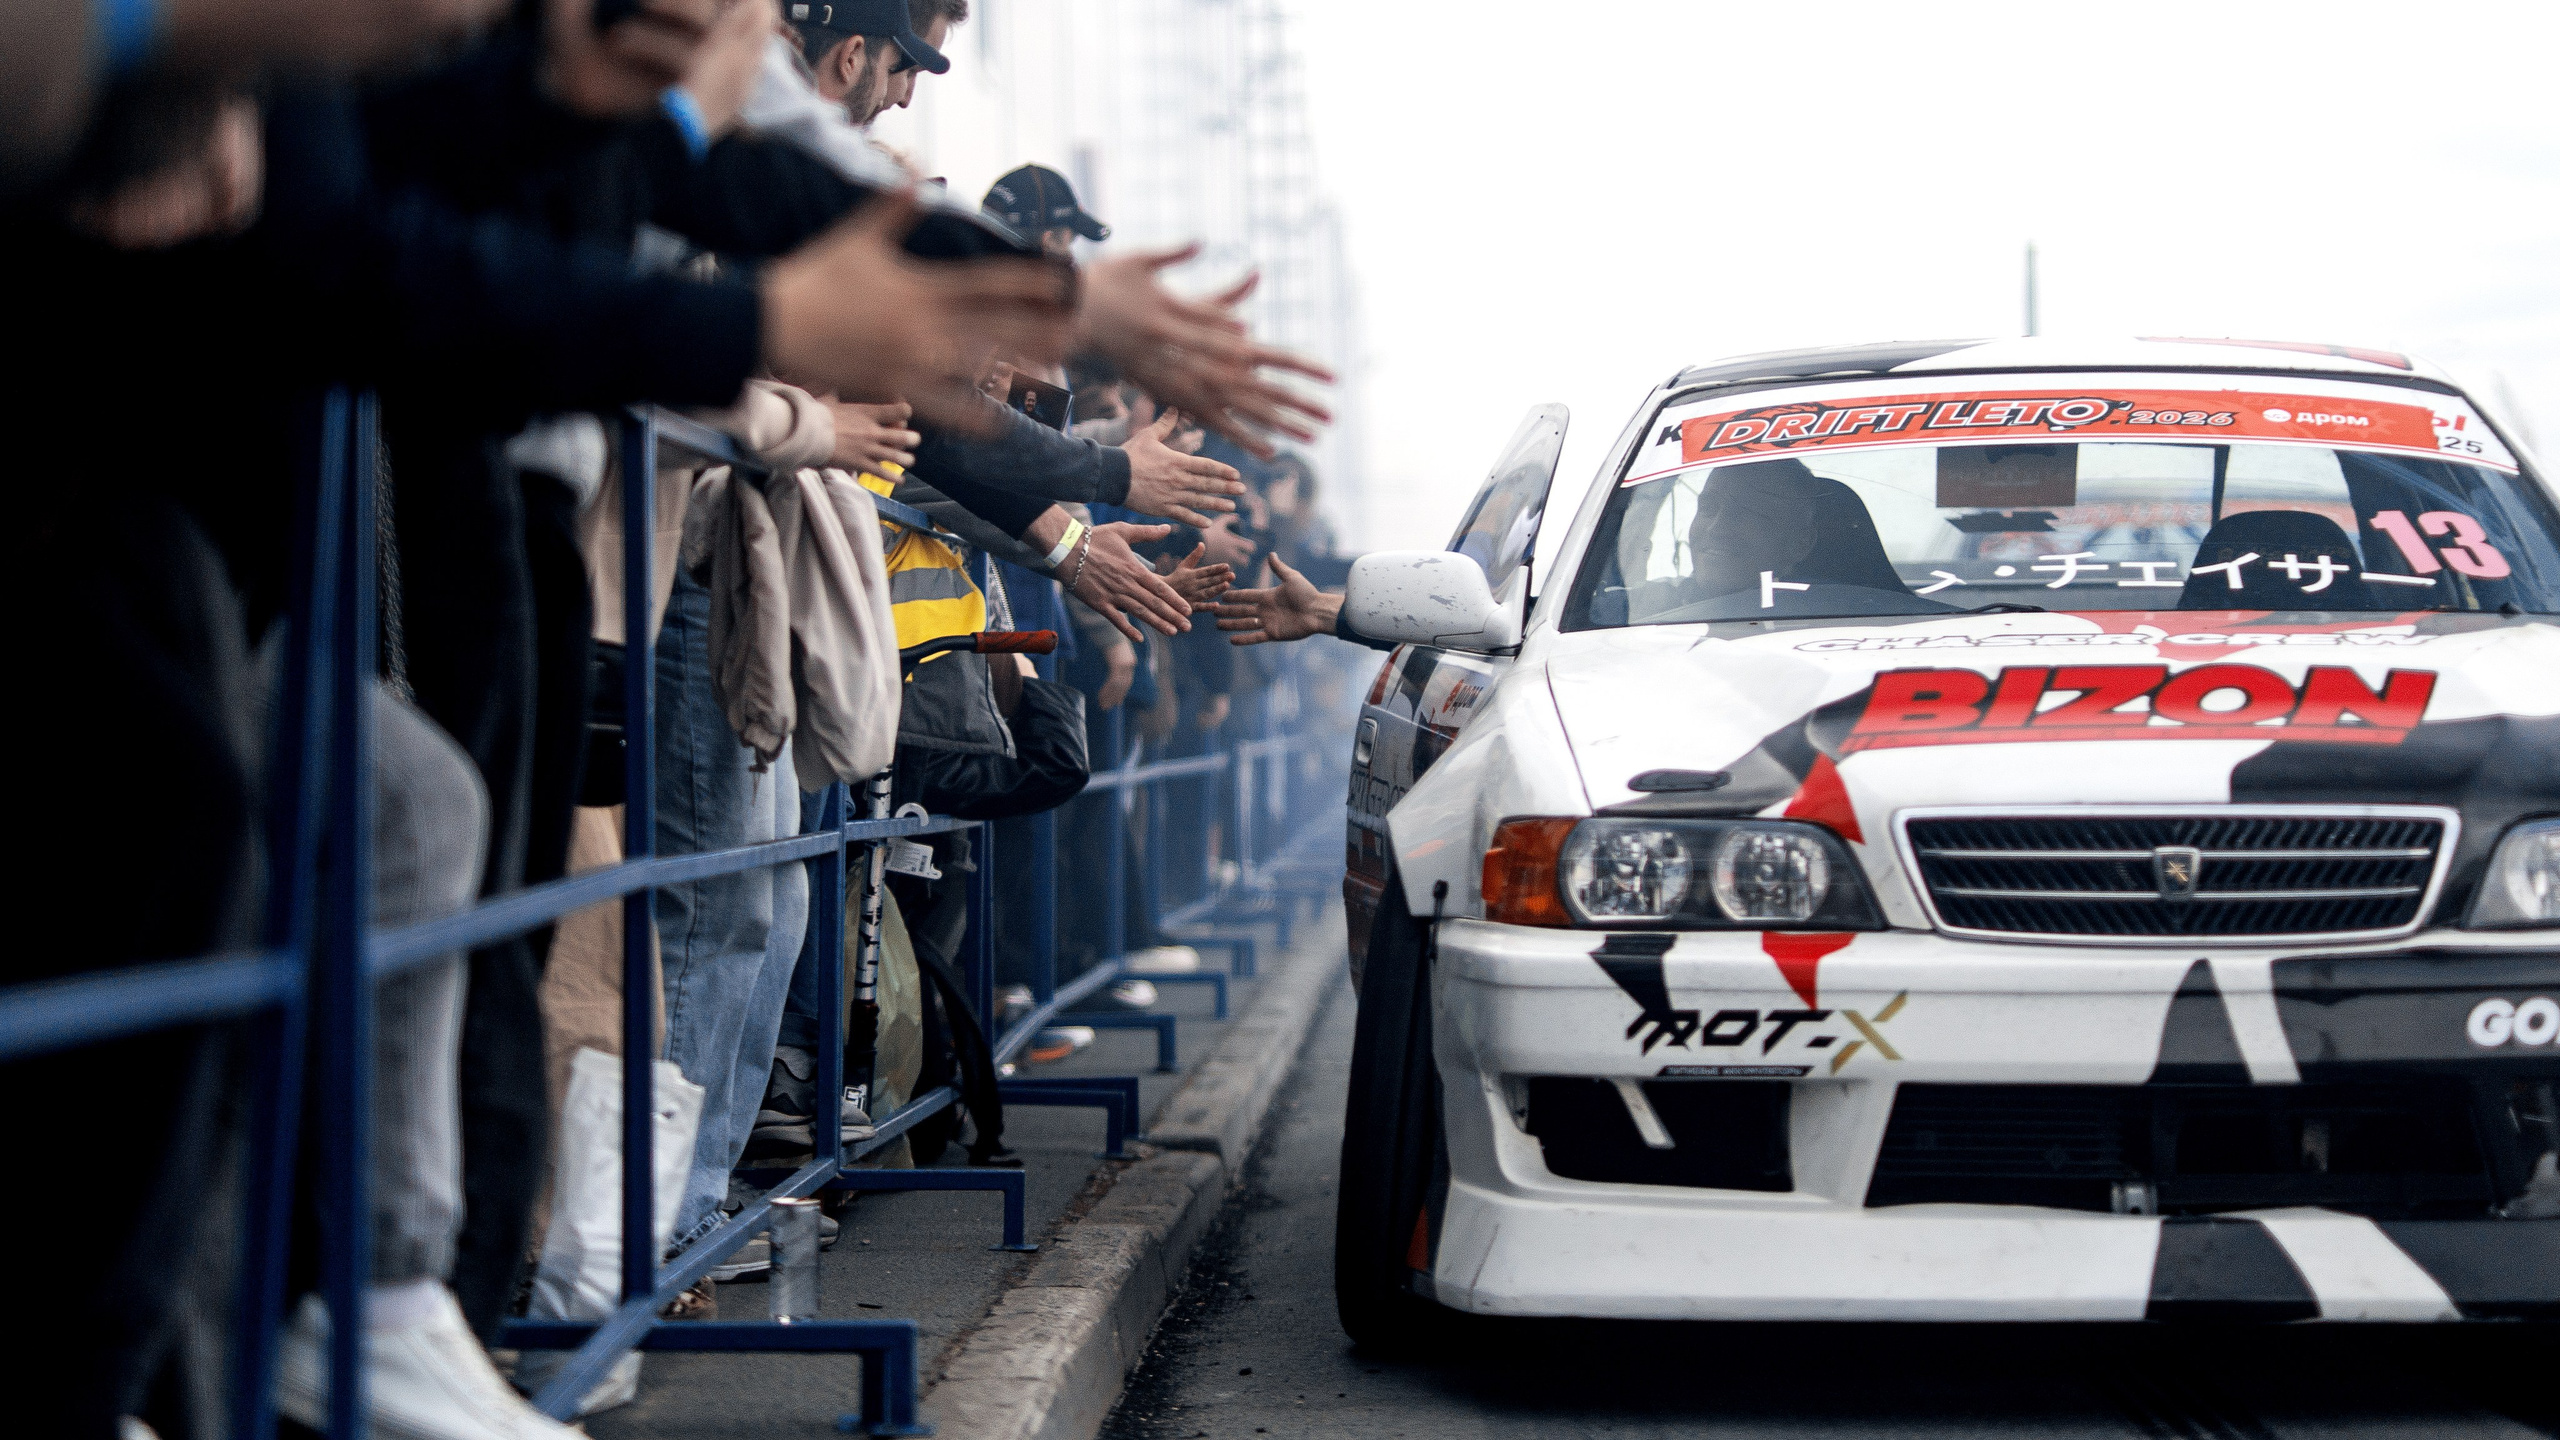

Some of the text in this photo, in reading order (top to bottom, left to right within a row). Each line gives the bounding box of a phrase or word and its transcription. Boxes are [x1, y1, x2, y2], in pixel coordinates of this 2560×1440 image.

[1702, 402, 1926, 452] DRIFT
[2126, 410, 2235, 426] 2026
[2442, 436, 2483, 453] 25
[2369, 509, 2512, 579] 13
[1794, 632, 2442, 652] CHASER CREW
[1850, 663, 2438, 734] BIZON
[2467, 996, 2560, 1048] GO
